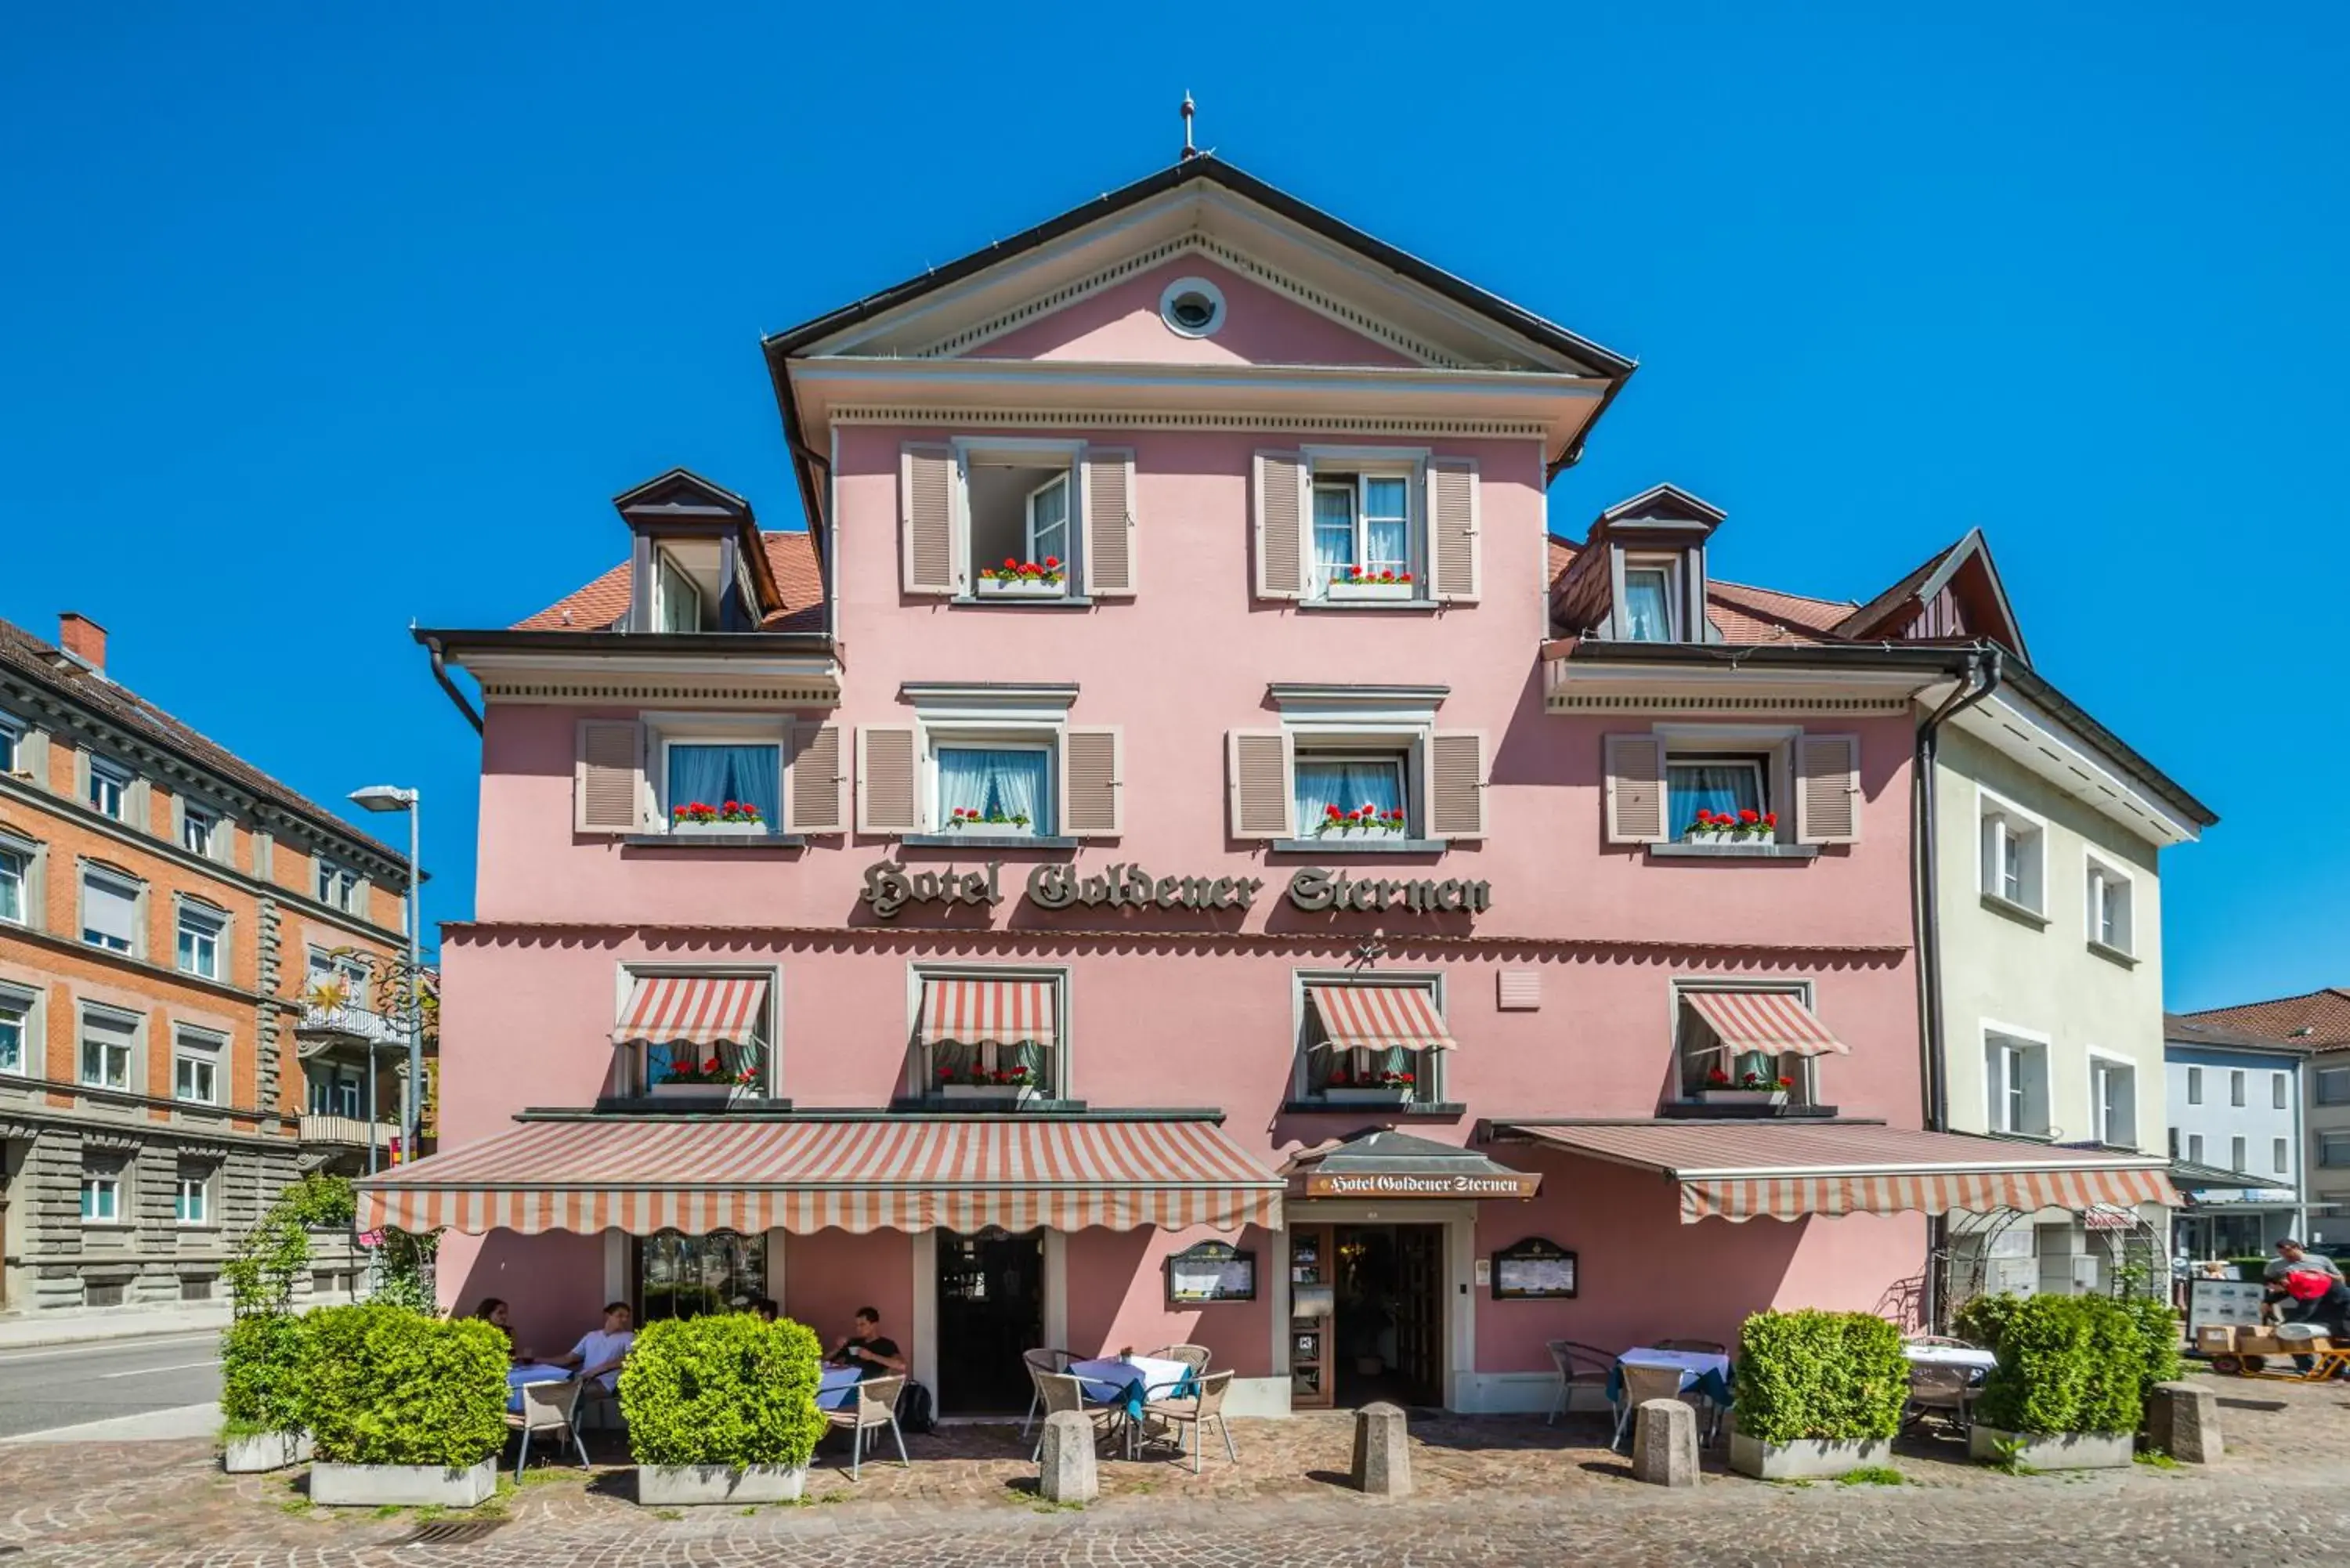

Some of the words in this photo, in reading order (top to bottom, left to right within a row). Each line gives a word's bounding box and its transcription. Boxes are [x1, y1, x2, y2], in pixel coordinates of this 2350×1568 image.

[860, 858, 1004, 917] Hotel
[1027, 862, 1264, 909] Goldener
[1289, 866, 1491, 913] Sternen
[1330, 1176, 1374, 1193] Hotel
[1377, 1176, 1451, 1192] Goldener
[1455, 1176, 1518, 1192] Sternen
